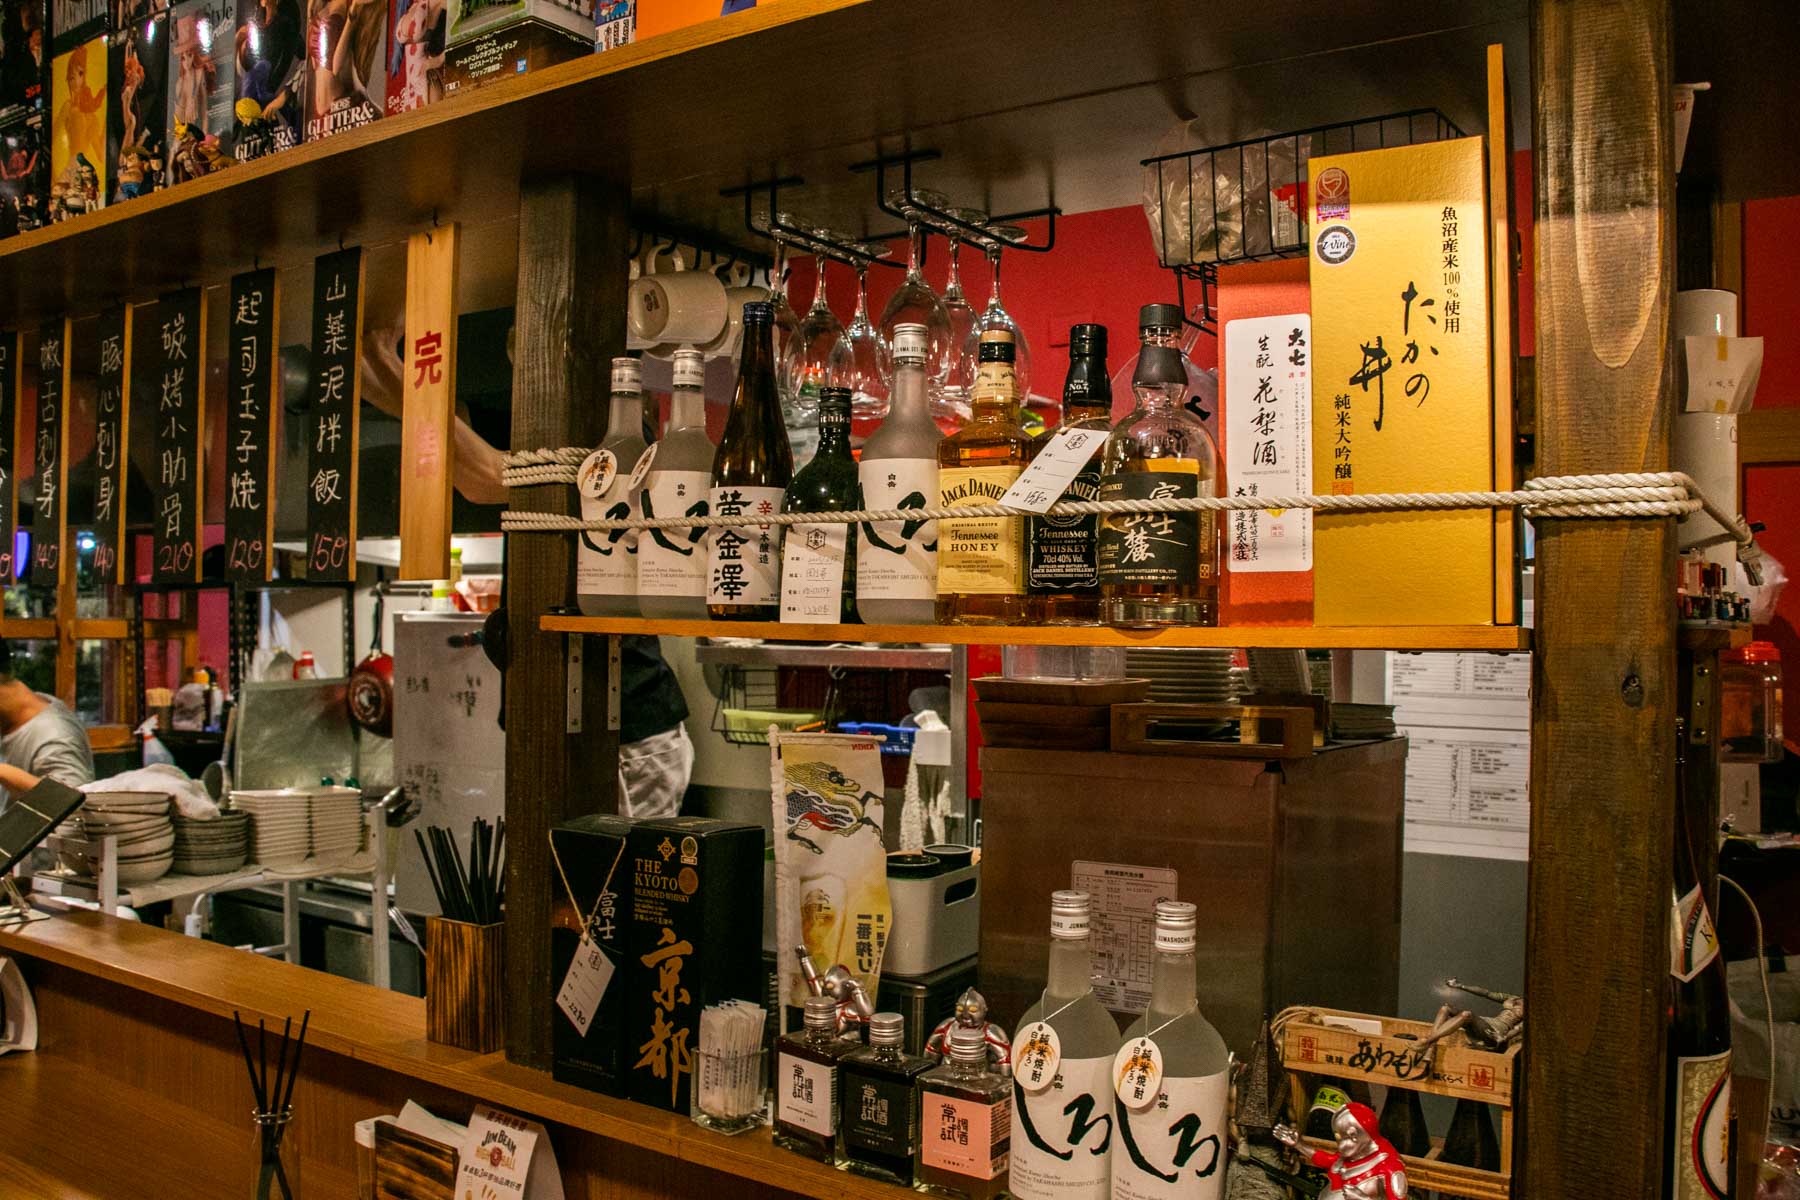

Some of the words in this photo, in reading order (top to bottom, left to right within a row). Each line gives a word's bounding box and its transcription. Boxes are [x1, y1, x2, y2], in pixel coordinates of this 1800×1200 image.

[1441, 206, 1461, 334] 魚沼産米100%使用
[1288, 327, 1306, 367] 大七
[1401, 280, 1438, 408] たかの
[1349, 336, 1391, 431] 井
[1250, 375, 1278, 466] 花梨酒
[1334, 393, 1352, 479] 純米大吟醸
[941, 483, 967, 508] JACK
[951, 530, 999, 541] Tennessee
[951, 543, 999, 552] HONEY
[1040, 527, 1088, 539] Tennessee
[159, 543, 193, 572] 210
[230, 537, 262, 571] 120
[309, 532, 347, 571] 150
[1040, 545, 1087, 553] WHISKEY
[1043, 554, 1056, 563] 70cl
[1058, 554, 1071, 563] 40%
[635, 858, 662, 874] THE
[635, 872, 678, 891] KYOTO
[633, 927, 694, 1108] 京都
[481, 1130, 498, 1147] JIM
[498, 1129, 517, 1157] BEAM
